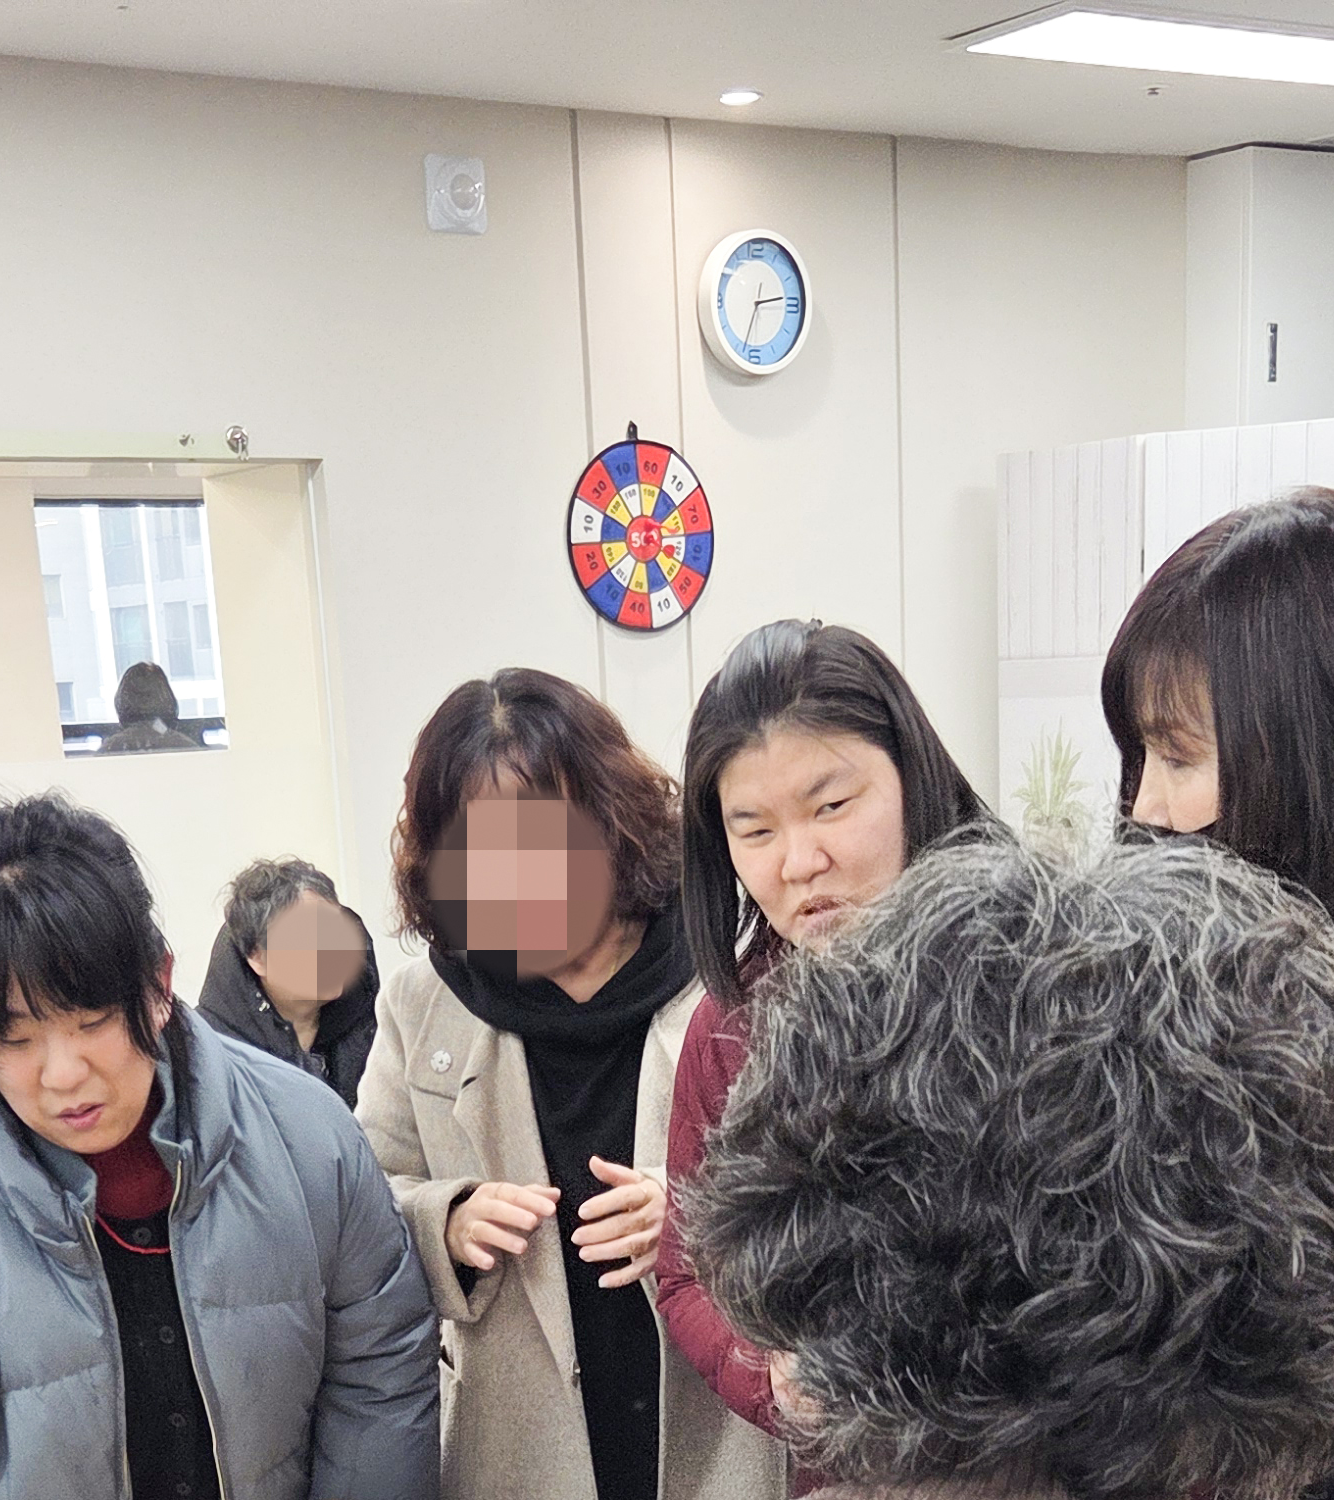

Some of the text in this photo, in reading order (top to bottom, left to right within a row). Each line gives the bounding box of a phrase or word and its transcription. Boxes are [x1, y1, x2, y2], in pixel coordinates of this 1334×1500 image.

[748, 241, 764, 258] 12
[786, 296, 800, 314] 3
[748, 349, 761, 364] 6
[617, 462, 629, 475] 10
[644, 461, 656, 473] 60
[593, 481, 606, 499] 30
[671, 475, 683, 491] 10
[688, 506, 698, 523] 70
[584, 516, 593, 532] 10
[587, 552, 598, 570] 20
[694, 546, 701, 561] 10
[607, 584, 618, 599] 10
[679, 578, 691, 593] 50
[631, 603, 644, 613] 40
[658, 599, 670, 611] 10
